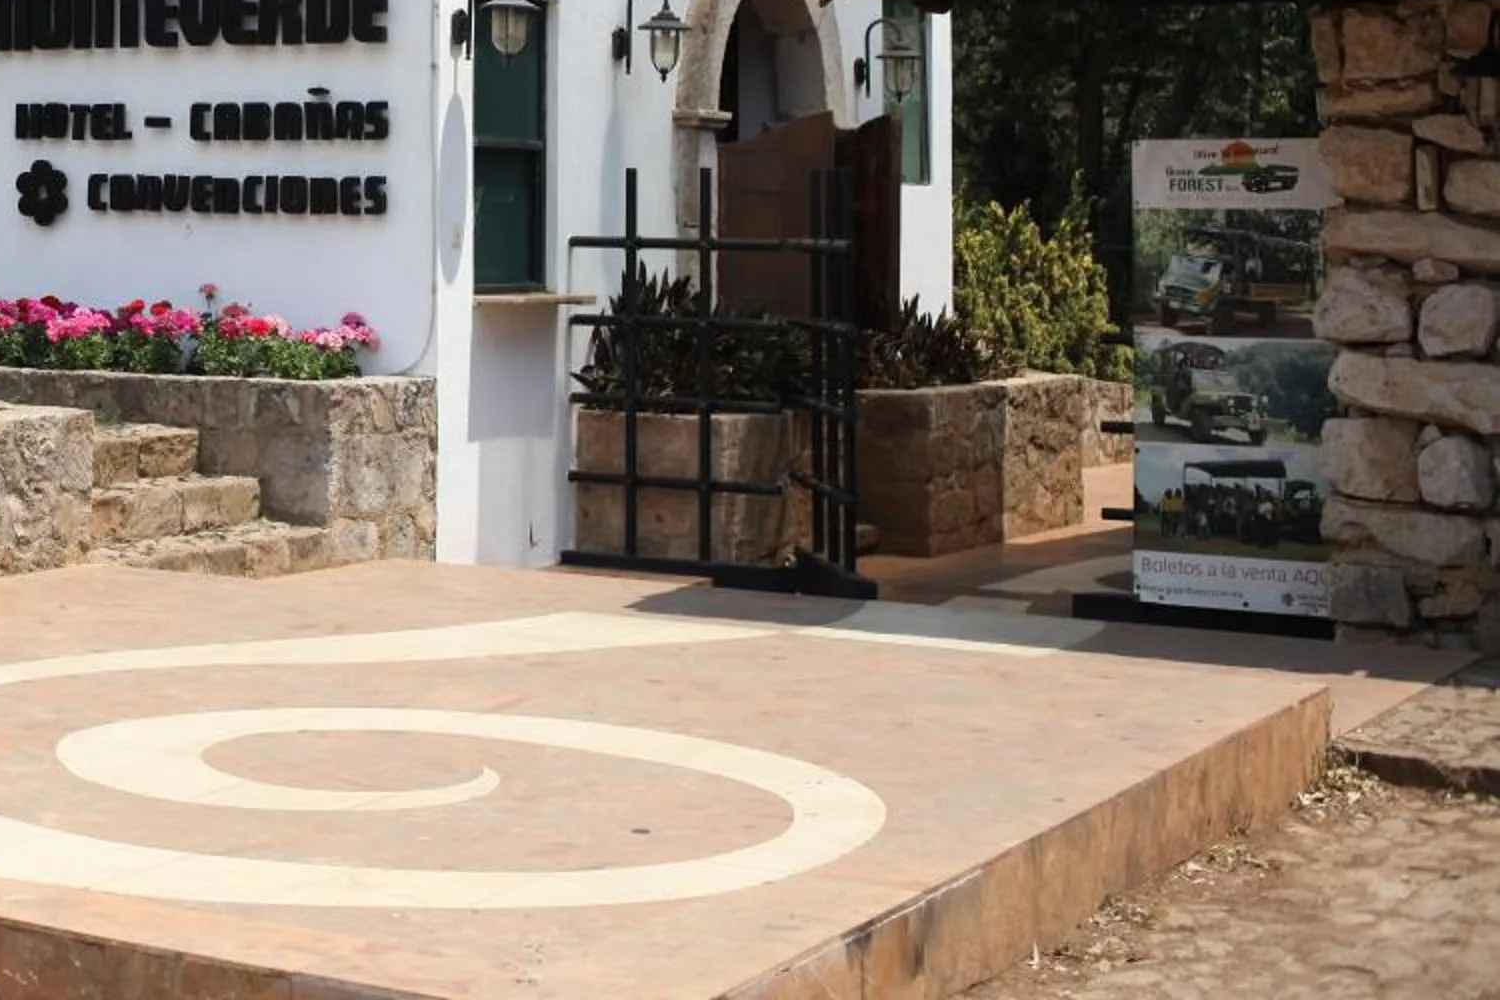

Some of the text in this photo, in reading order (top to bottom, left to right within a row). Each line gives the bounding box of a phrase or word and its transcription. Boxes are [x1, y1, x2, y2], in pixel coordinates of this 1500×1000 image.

[15, 102, 133, 140] HOTEL
[190, 86, 389, 140] CABAÑAS
[87, 173, 388, 215] CONVENCIONES
[1169, 177, 1224, 193] FOREST
[1141, 556, 1202, 578] Boletos
[1207, 565, 1217, 577] a
[1221, 562, 1236, 579] la
[1241, 567, 1288, 583] venta
